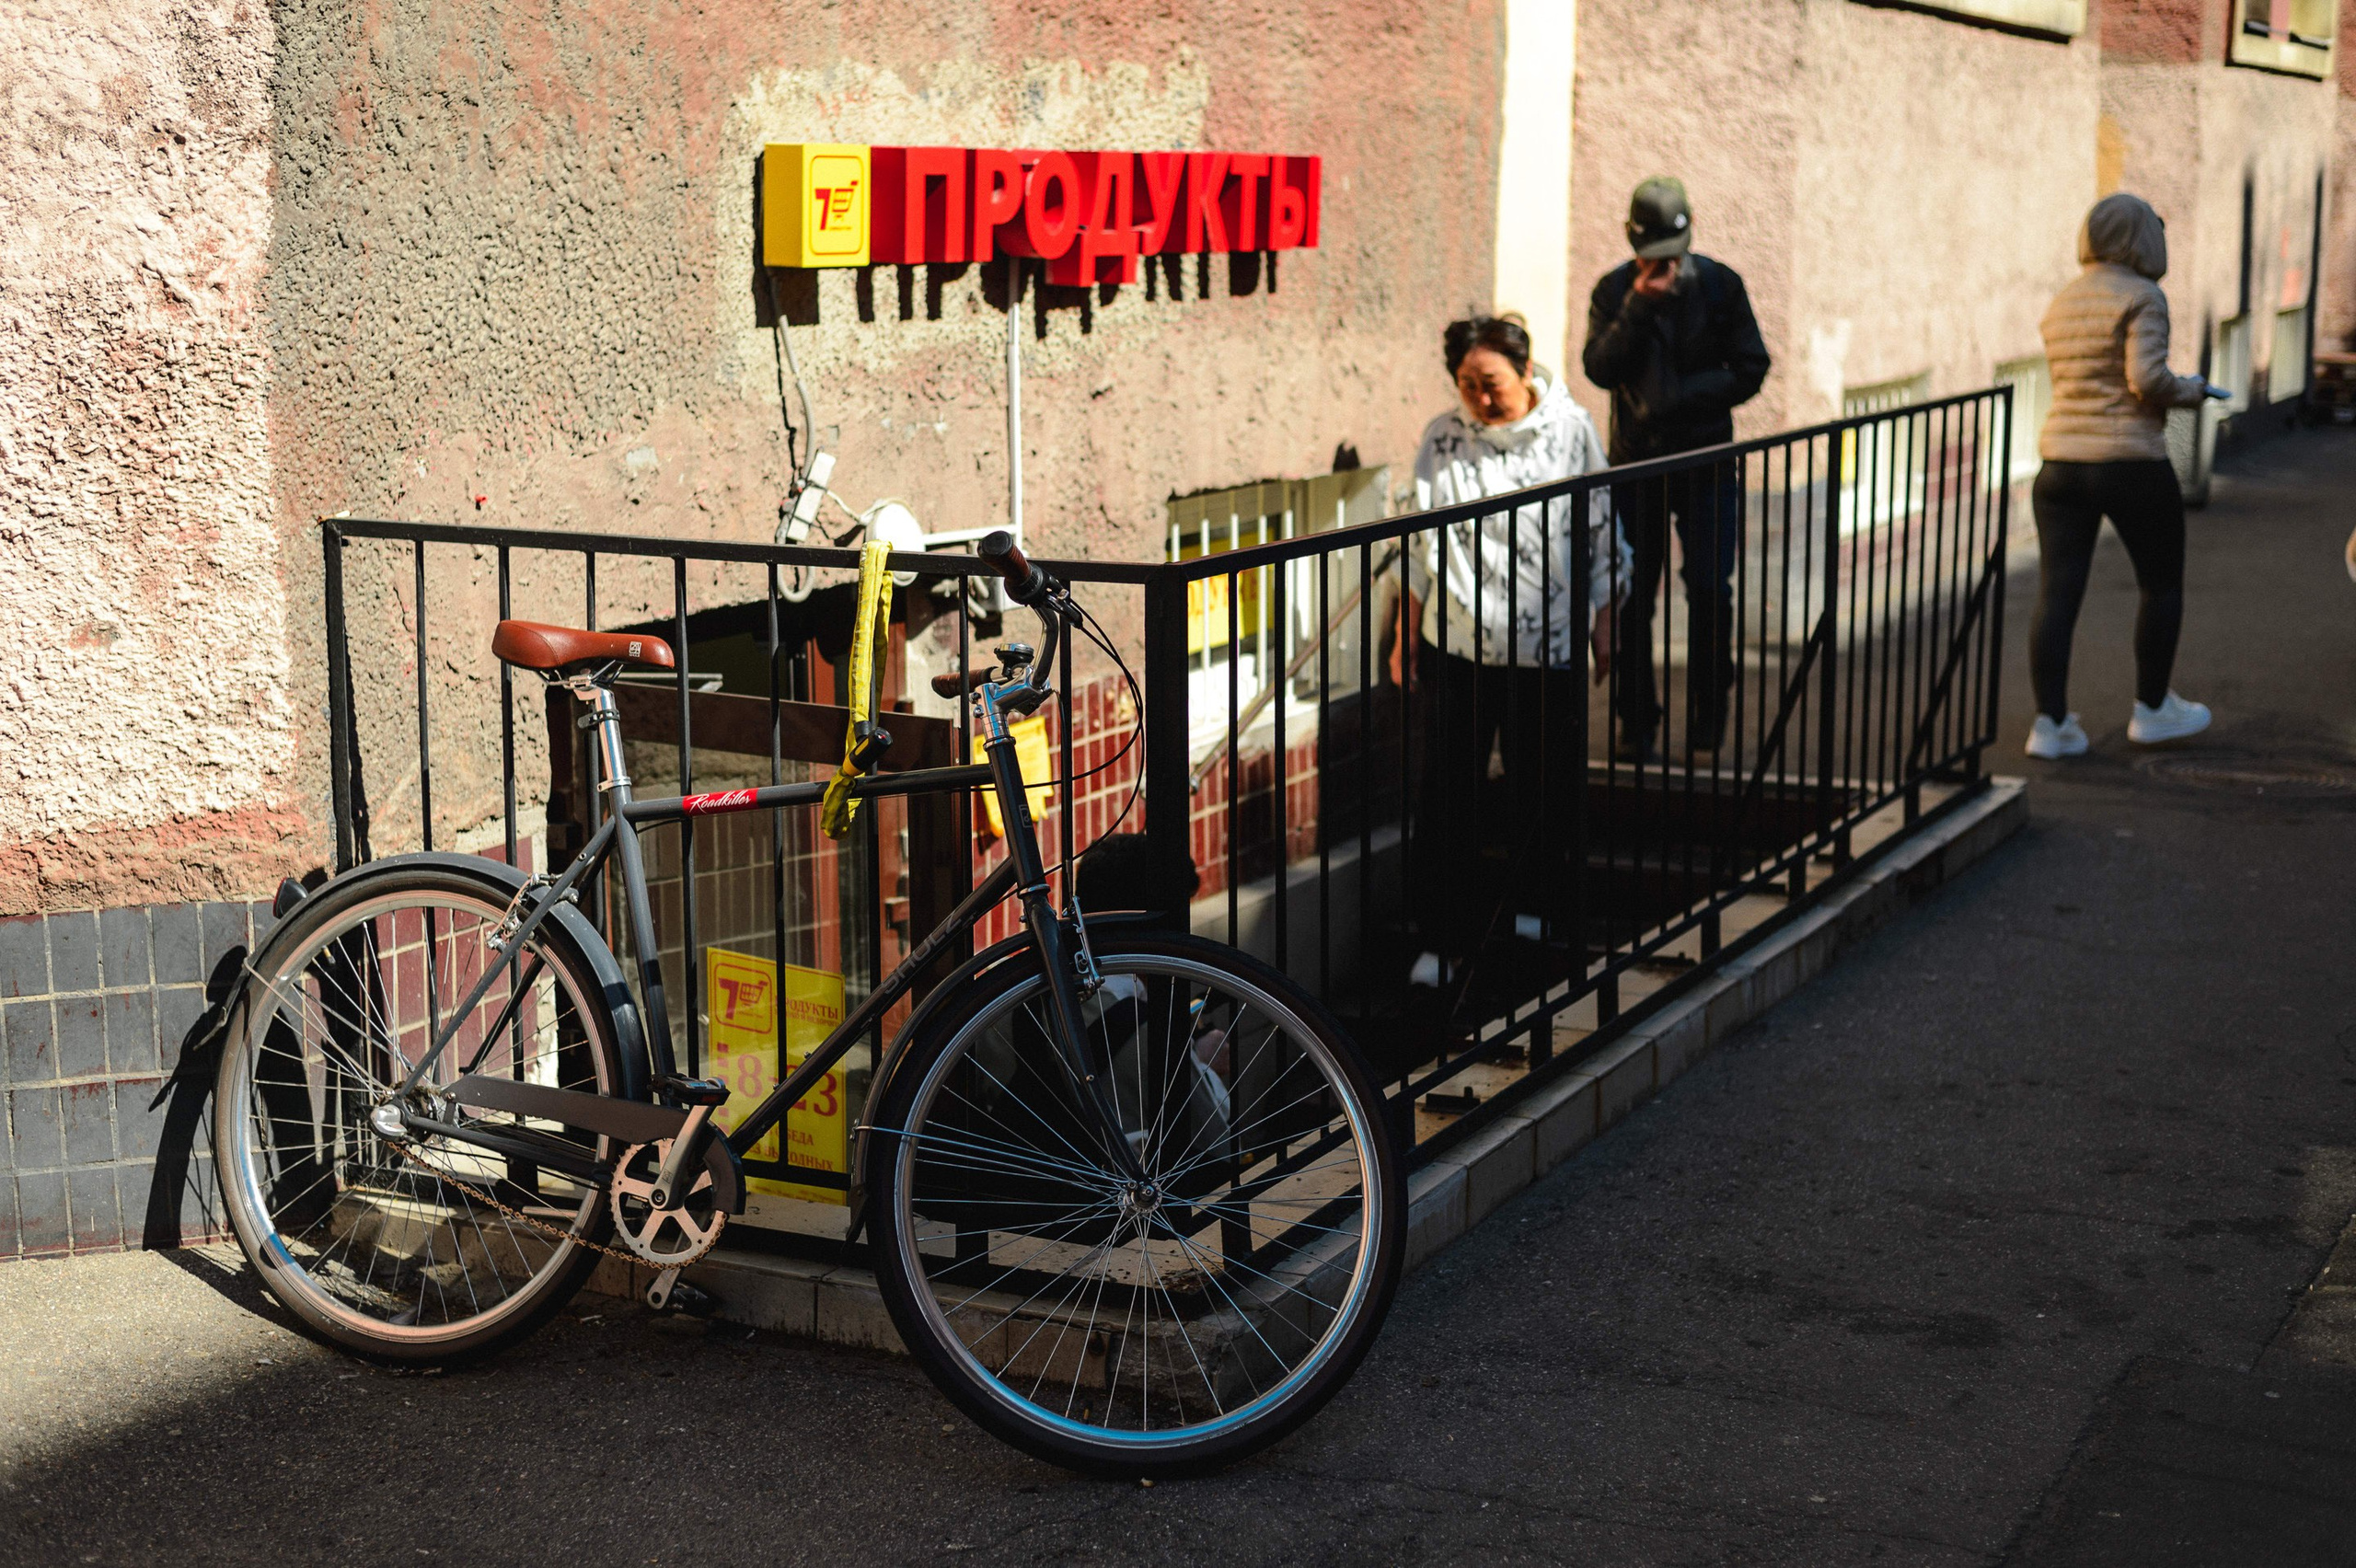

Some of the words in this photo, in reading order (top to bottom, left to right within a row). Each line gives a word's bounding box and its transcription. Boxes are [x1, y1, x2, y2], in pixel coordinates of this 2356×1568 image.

[906, 145, 1322, 287] ПРОДУКТЫ
[881, 912, 963, 994] SHULZ
[774, 995, 838, 1020] ОДУКТЫ
[765, 1145, 834, 1171] ВЫОДНЫХ
